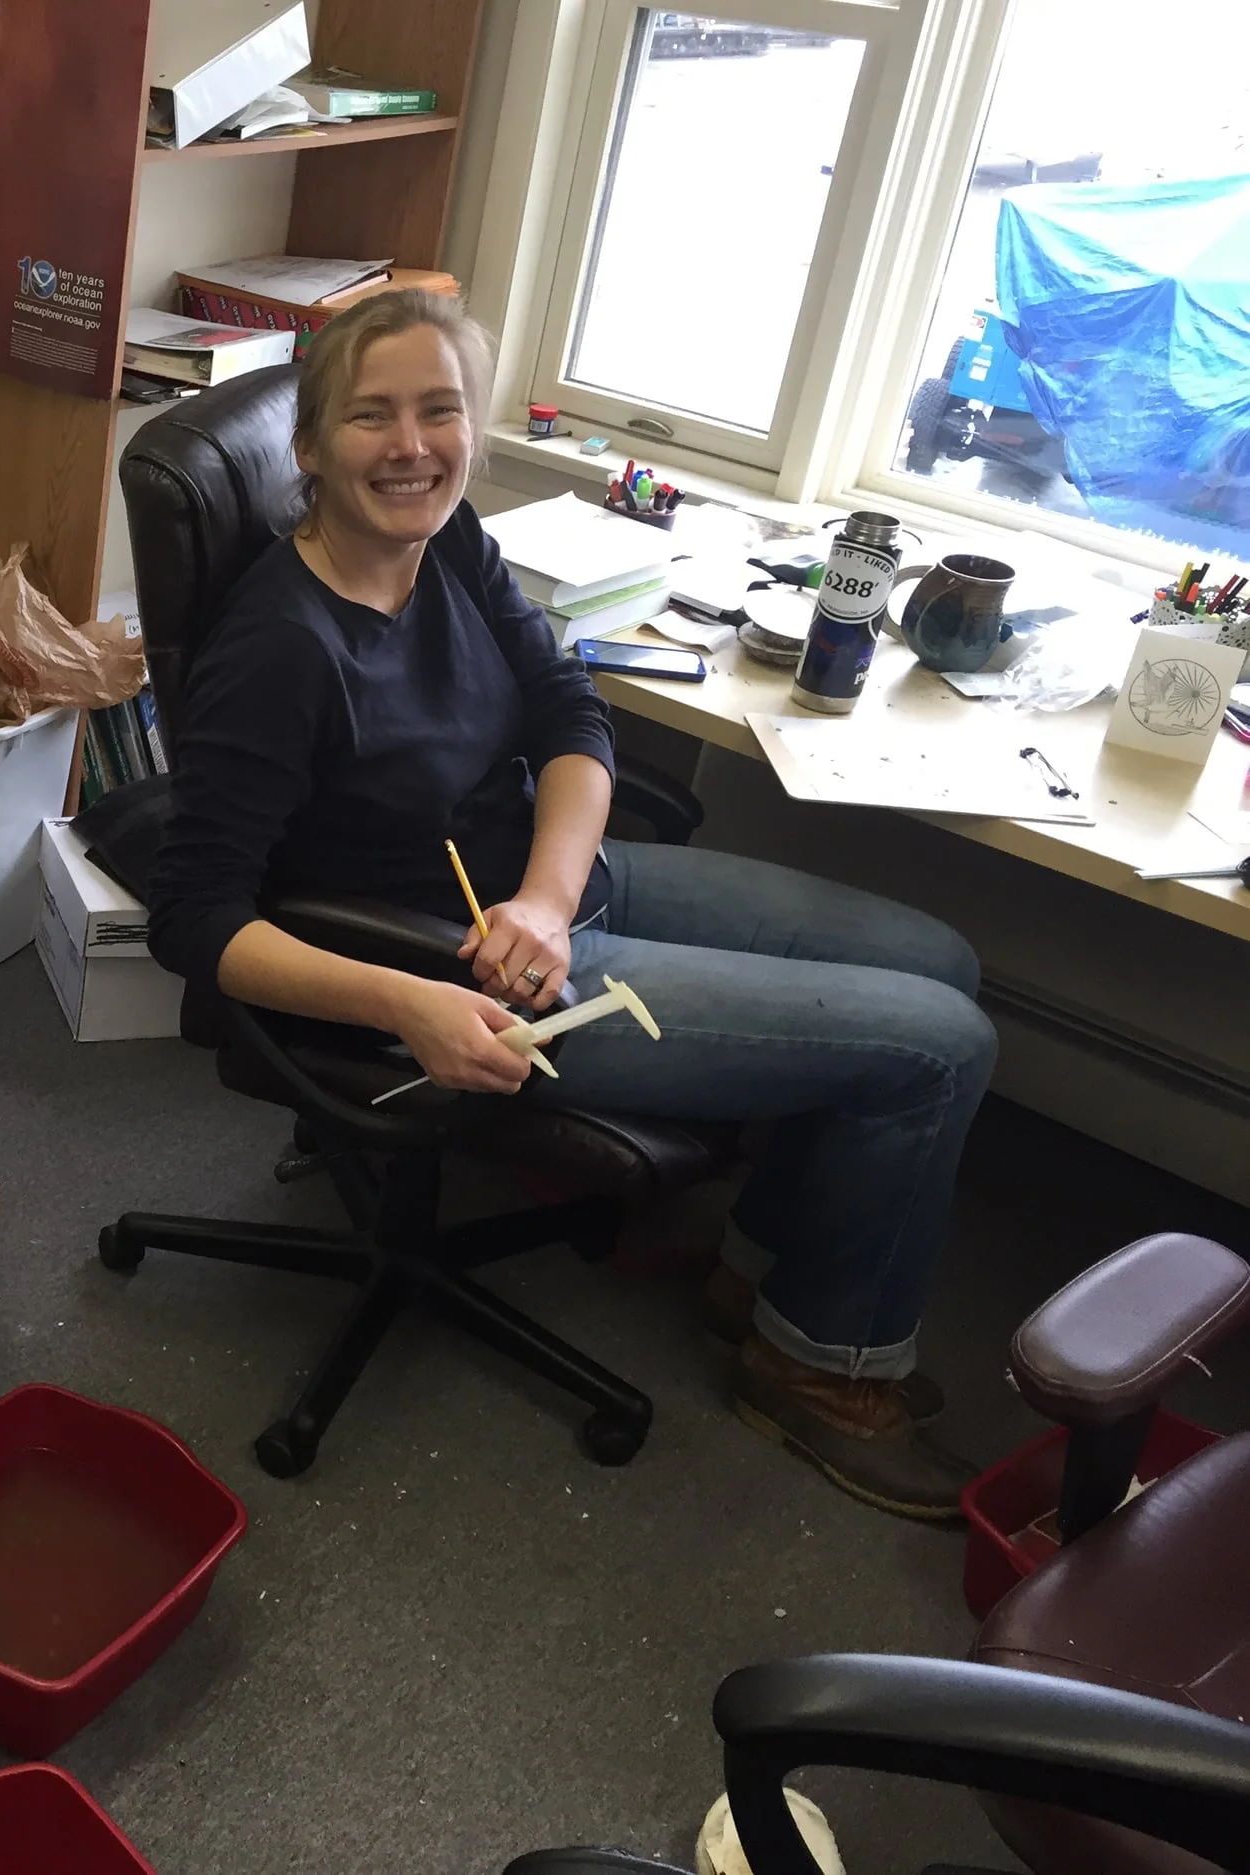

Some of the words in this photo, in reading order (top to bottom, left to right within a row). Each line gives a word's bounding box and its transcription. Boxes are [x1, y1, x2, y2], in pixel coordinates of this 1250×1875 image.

[60, 282, 70, 292] of
[72, 285, 104, 300] ocean
[76, 274, 105, 289] years
[53, 292, 102, 312] exploration
[843, 549, 854, 559] IT
[864, 555, 891, 574] LIKED
